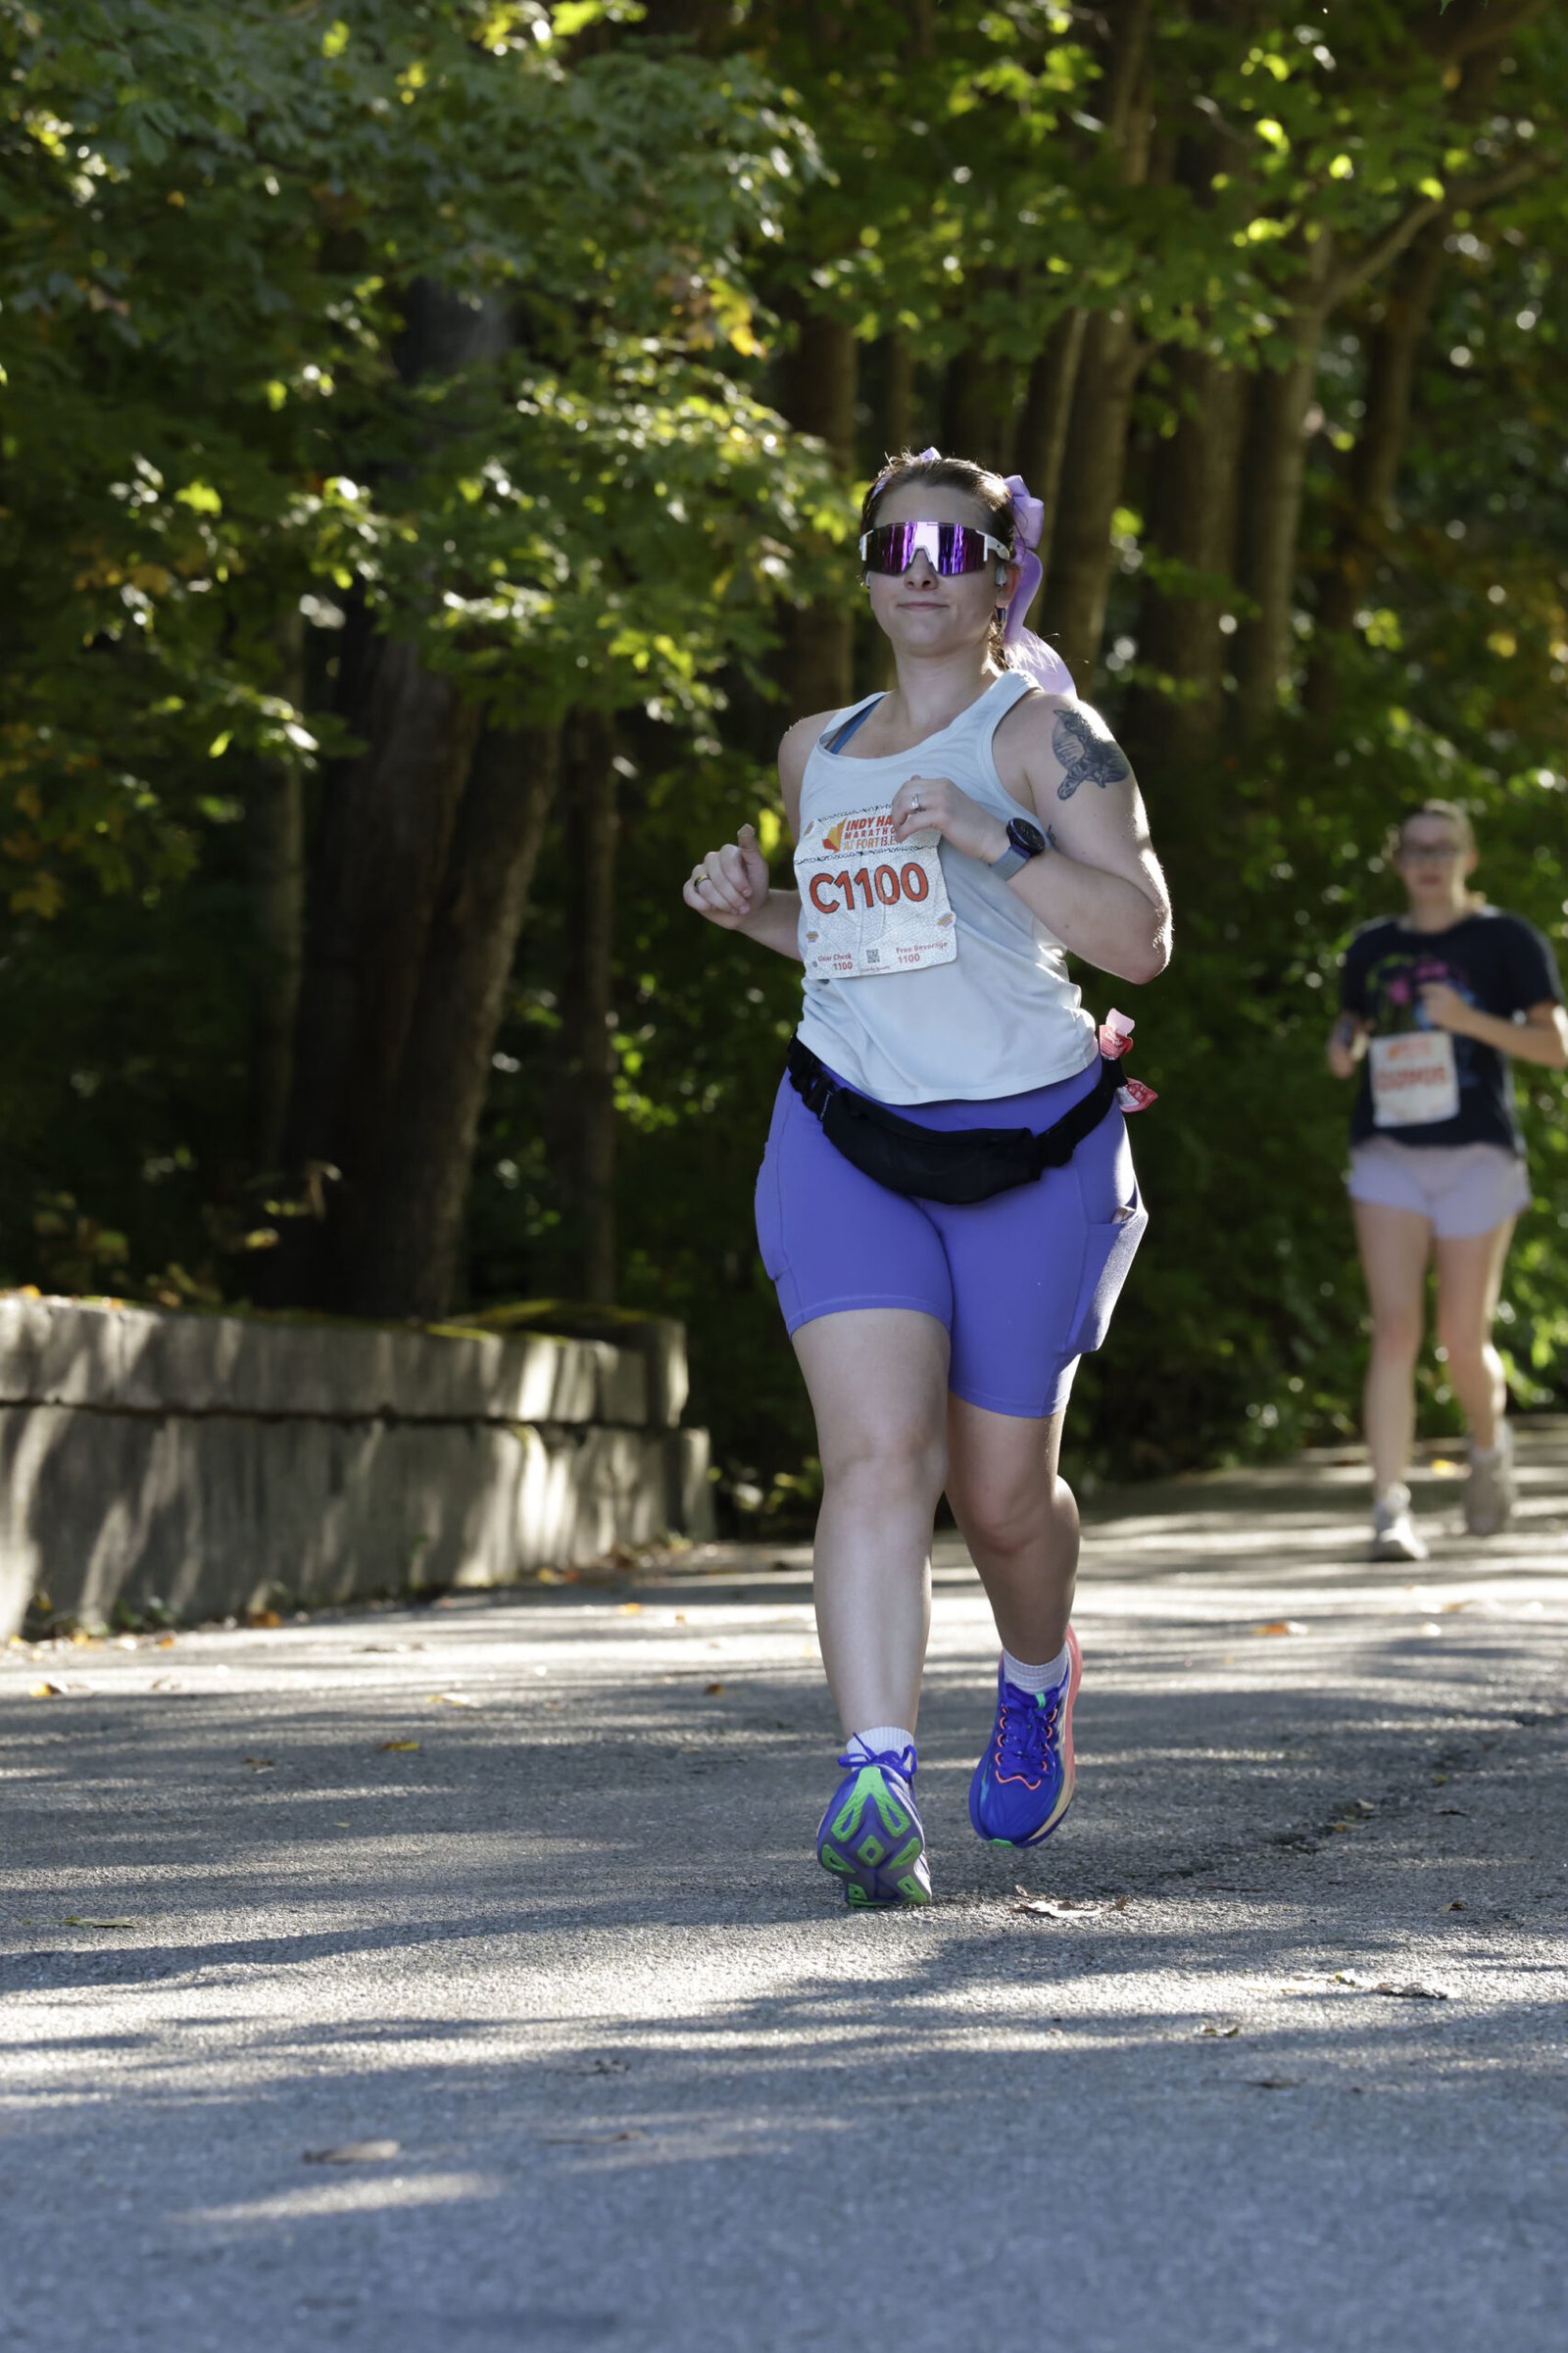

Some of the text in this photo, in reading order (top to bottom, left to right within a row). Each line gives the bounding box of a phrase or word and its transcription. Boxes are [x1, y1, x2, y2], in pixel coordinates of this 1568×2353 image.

[846, 814, 893, 831] INDY HA
[845, 825, 896, 840] MARATHO
[844, 840, 854, 850] AT
[857, 837, 880, 850] FORT
[808, 861, 929, 914] C1100
[913, 941, 948, 952] Beverage
[898, 954, 920, 963] 1100
[833, 961, 854, 971] 1100
